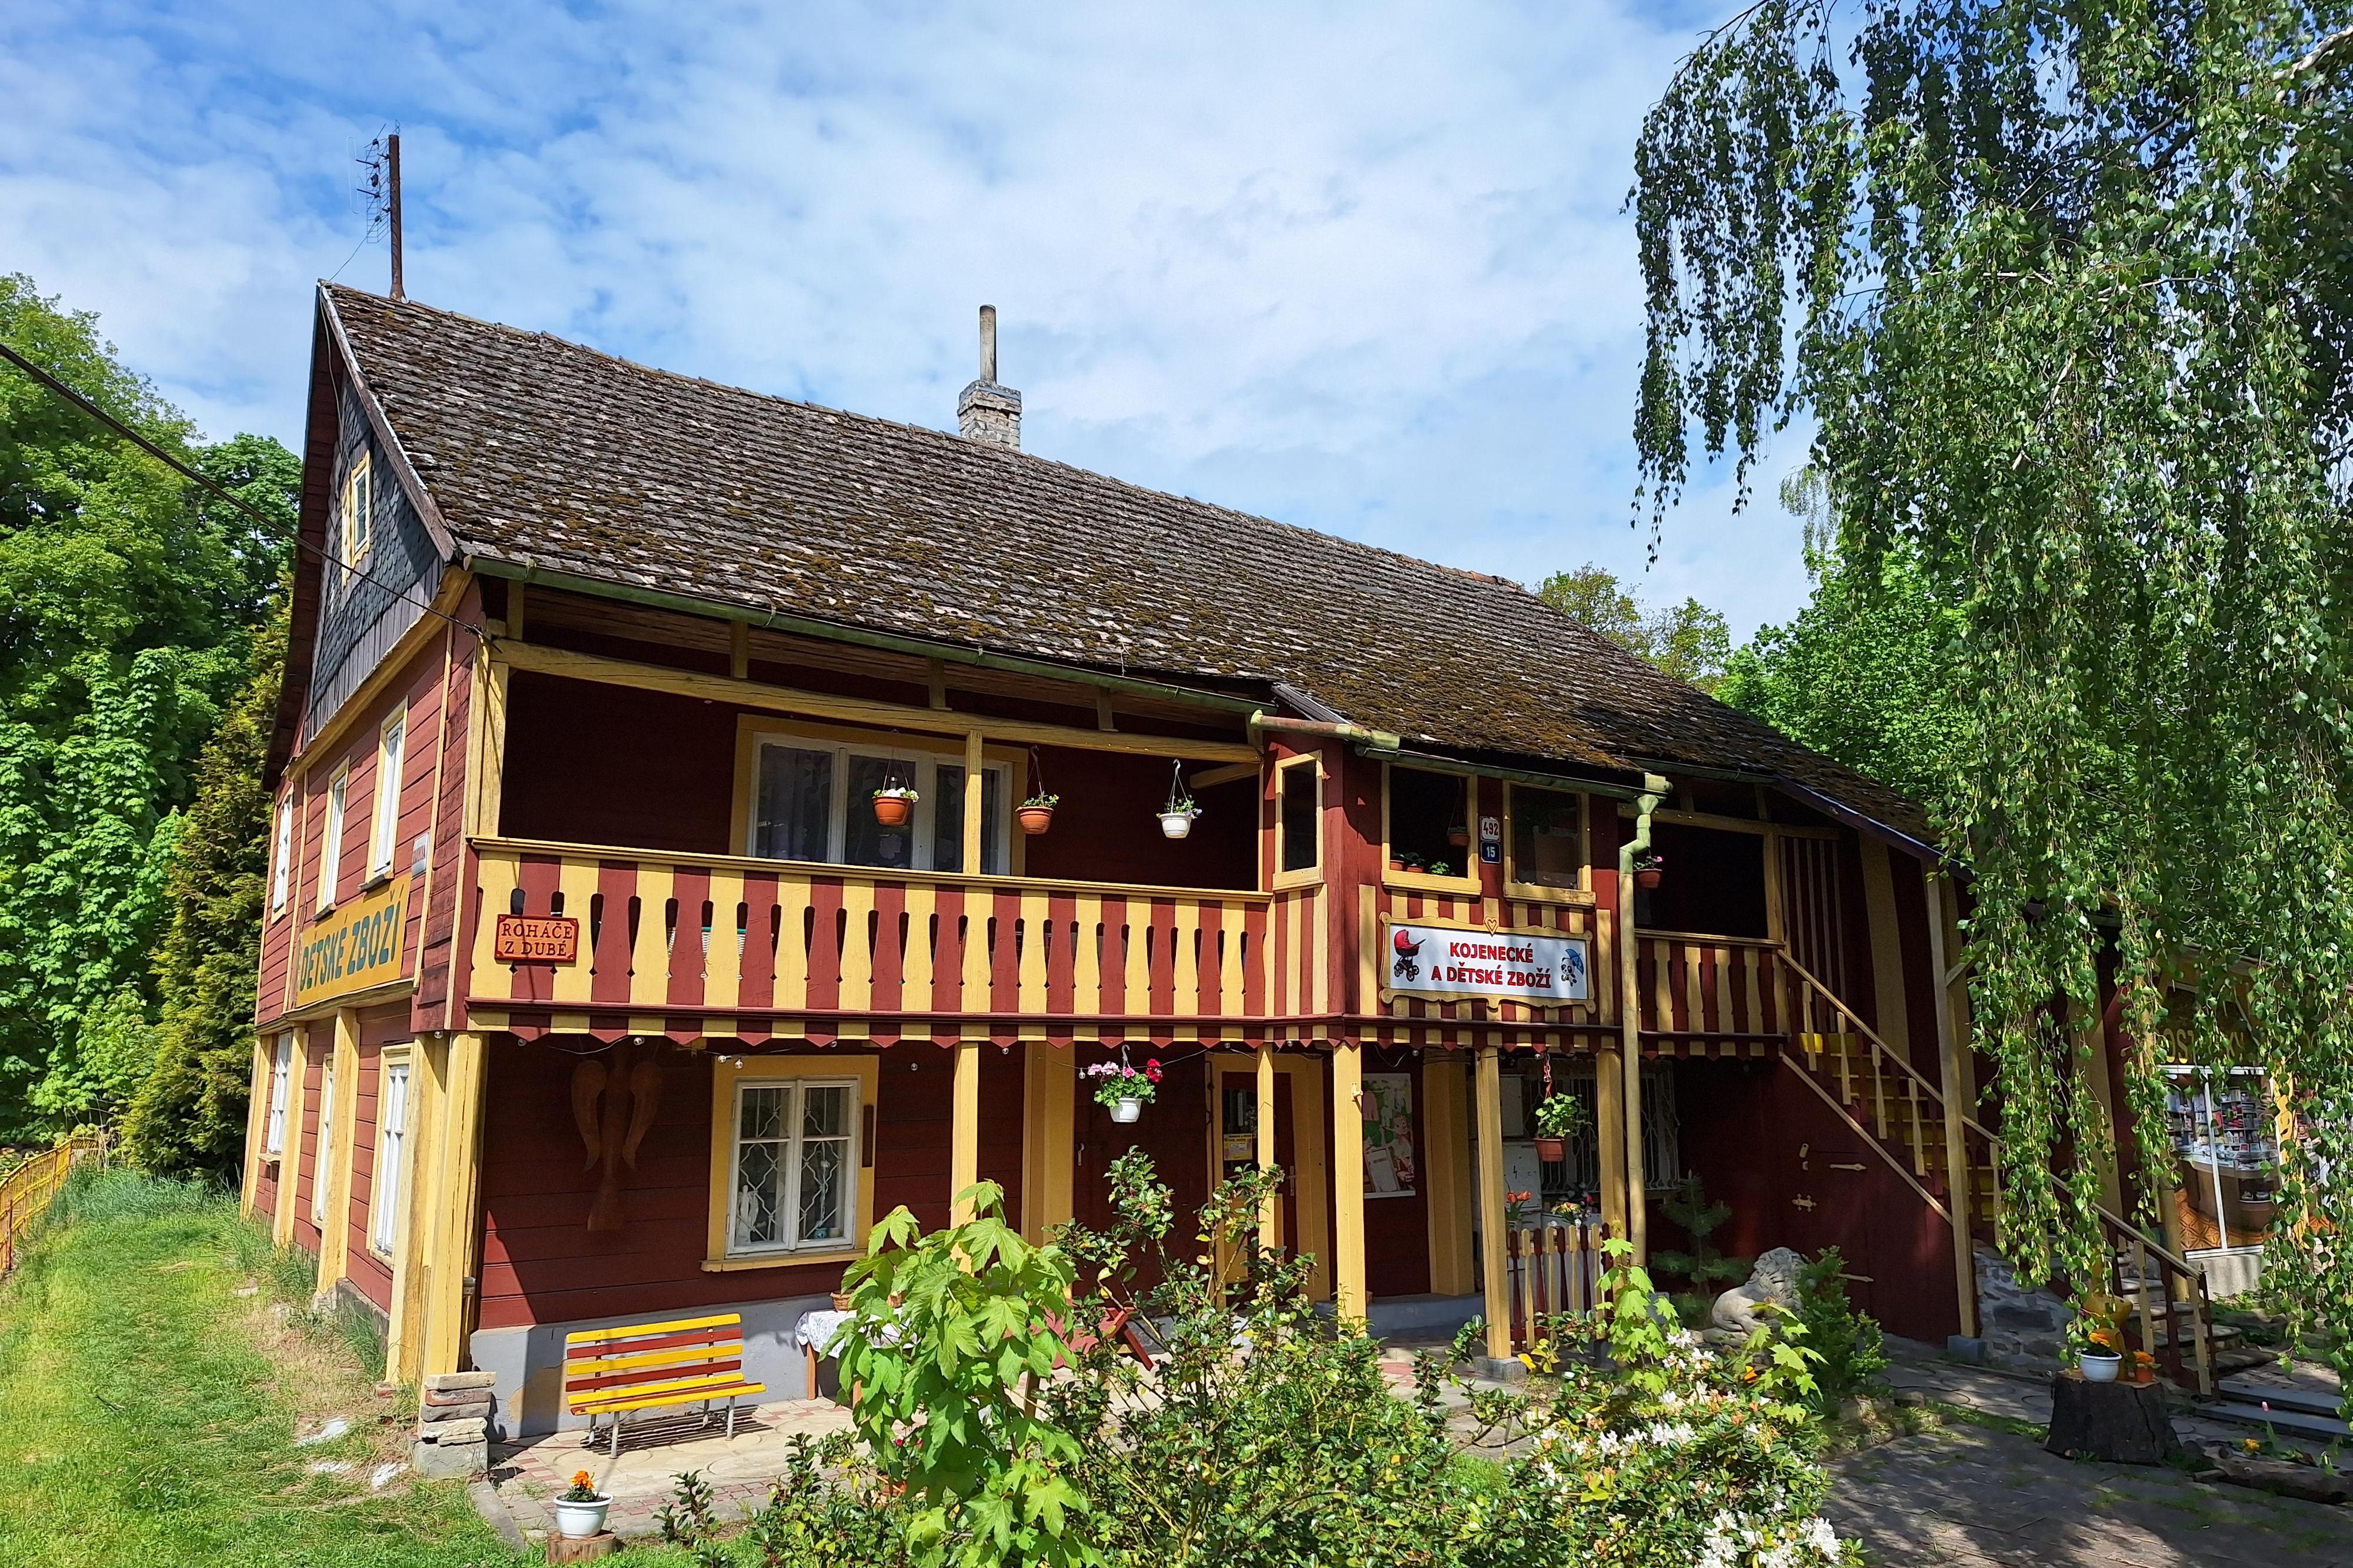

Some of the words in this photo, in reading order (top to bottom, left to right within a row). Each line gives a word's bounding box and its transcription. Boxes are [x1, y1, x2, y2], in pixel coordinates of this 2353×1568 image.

[1483, 822, 1498, 835] 492
[1487, 846, 1495, 858] 15
[299, 913, 348, 991] DĚTSKÉ
[347, 883, 404, 975] ZBOŽÍ
[501, 922, 572, 939] ROHÁČE
[504, 941, 514, 954] Z
[521, 940, 566, 956] DUBÉ
[1450, 942, 1534, 963] KOJENECKÉ
[1431, 966, 1442, 980] A
[1447, 962, 1502, 985] DĚTSKÉ
[1507, 968, 1551, 989] ZBOŽÍ
